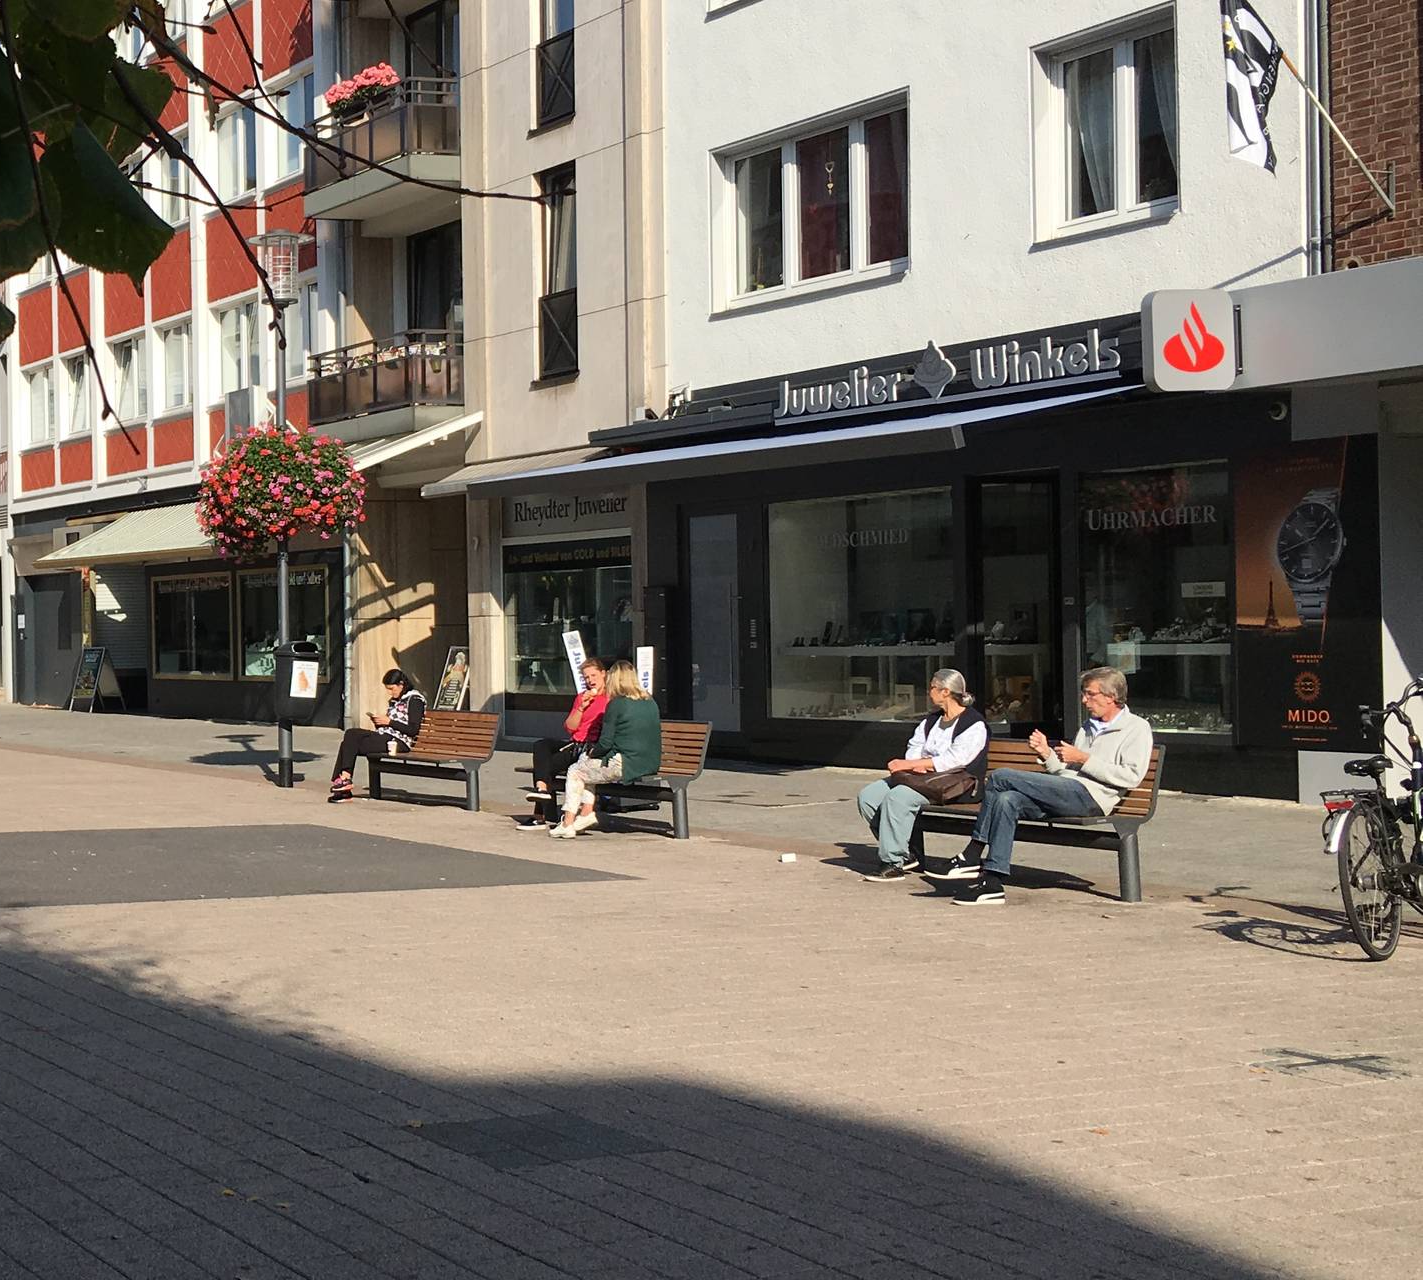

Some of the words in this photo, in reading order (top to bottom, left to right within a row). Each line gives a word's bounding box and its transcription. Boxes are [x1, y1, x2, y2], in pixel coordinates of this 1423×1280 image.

[774, 365, 902, 418] Juwelier
[969, 328, 1121, 389] Winkels
[514, 500, 570, 527] Rheydter
[573, 496, 627, 521] Juwelier
[1287, 709, 1330, 723] MIDO
